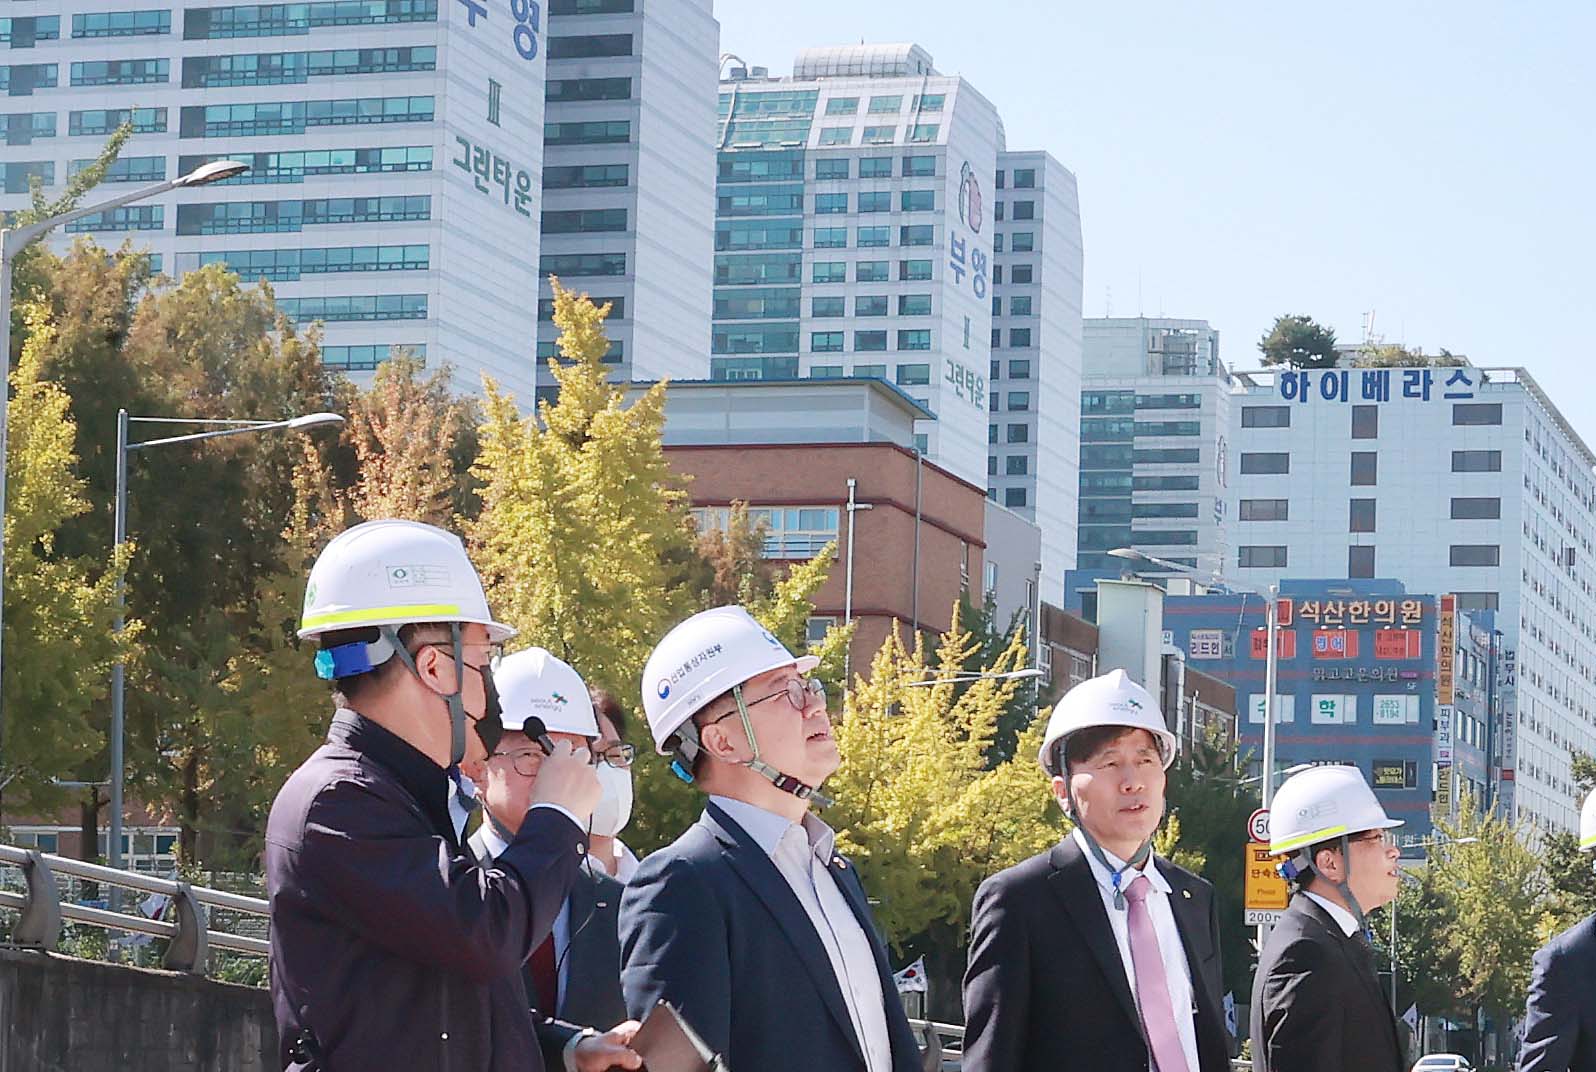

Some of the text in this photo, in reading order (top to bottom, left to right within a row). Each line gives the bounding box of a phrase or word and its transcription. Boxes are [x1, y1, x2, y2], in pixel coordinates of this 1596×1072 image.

[453, 135, 532, 218] 그린타운
[950, 231, 987, 299] 부영
[945, 359, 984, 410] 그린타운
[1280, 370, 1474, 402] 하이베라스
[1299, 600, 1423, 624] 석산한의원
[670, 643, 724, 685] 산업통상자원부
[1440, 615, 1452, 687] 석산한의원
[1504, 649, 1515, 686] 법무사
[1319, 700, 1336, 718] 학
[1440, 708, 1450, 743] 피부과
